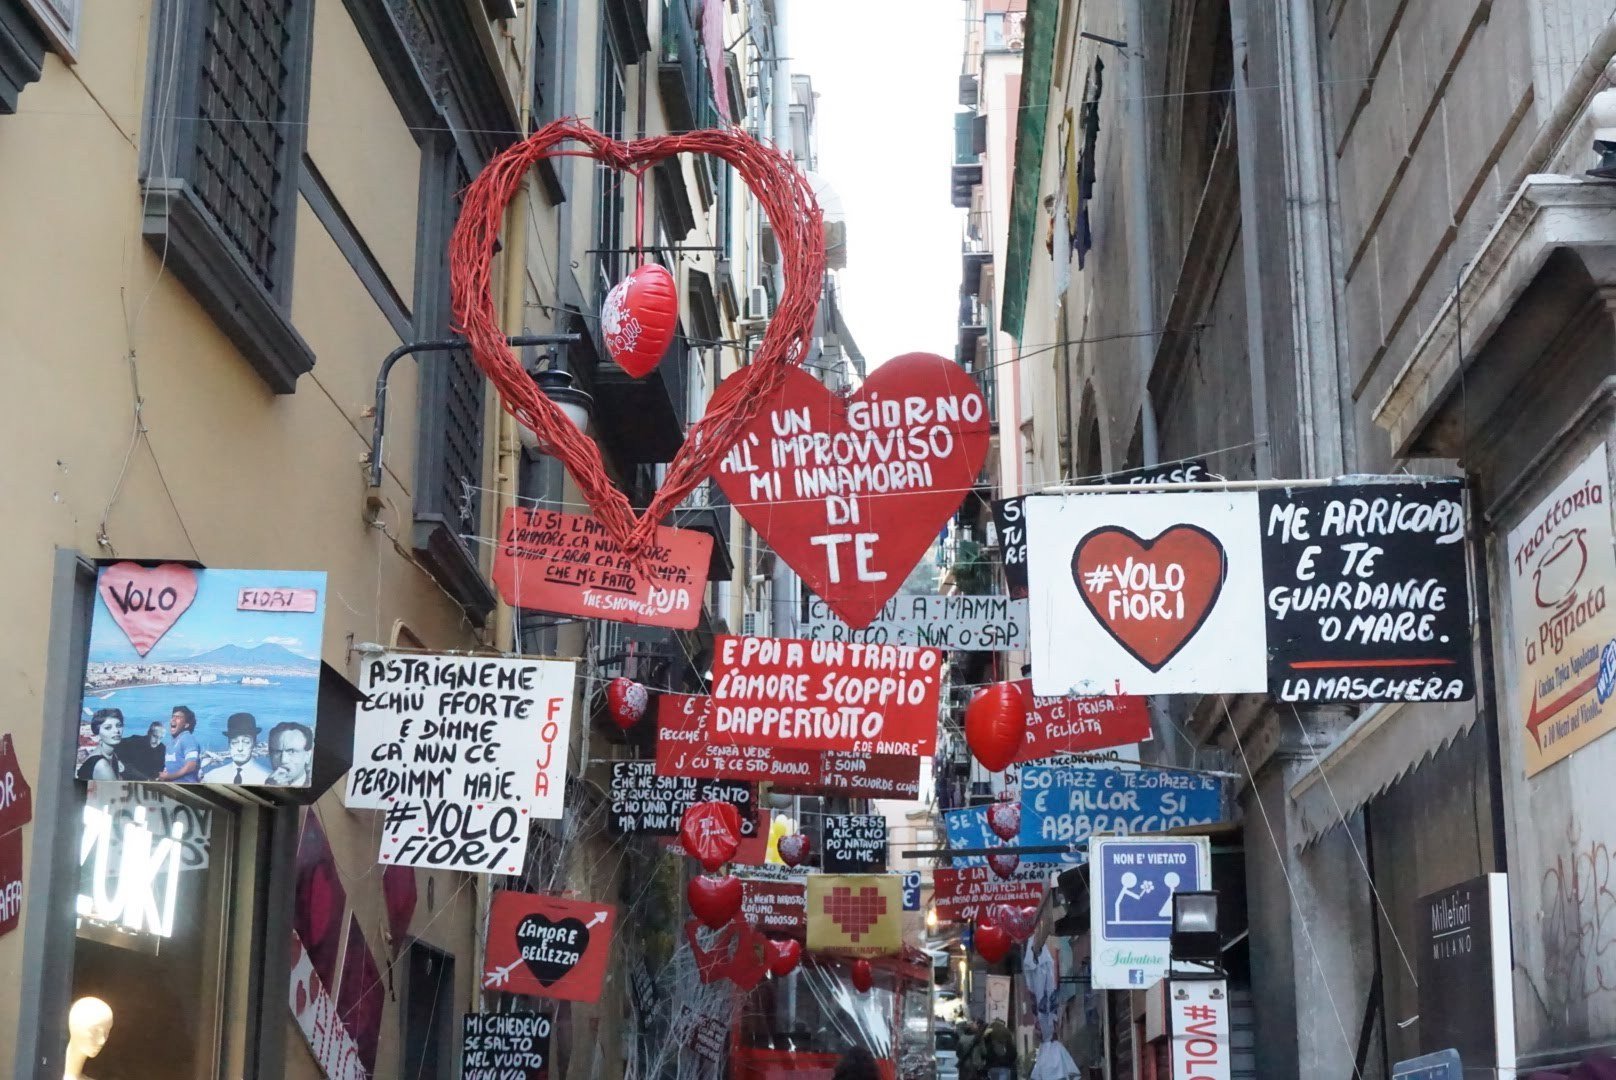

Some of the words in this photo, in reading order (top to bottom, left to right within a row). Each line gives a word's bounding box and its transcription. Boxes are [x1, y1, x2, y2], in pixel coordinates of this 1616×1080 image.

[771, 407, 811, 436] UN
[750, 470, 782, 501] MI
[794, 461, 932, 498] INNAMORAI
[825, 493, 860, 525] DI
[1268, 503, 1311, 544] ME
[810, 532, 887, 583] TE
[1296, 545, 1321, 580] E
[1340, 542, 1384, 578] TE
[546, 565, 571, 579] CHE
[601, 571, 636, 591] FATTO
[1084, 556, 1185, 593] #VOLO
[109, 581, 178, 616] VOLO
[241, 591, 294, 607] FIORI
[912, 598, 927, 620] A
[1108, 588, 1185, 621] FIORI
[1268, 578, 1447, 620] GUARDANNE
[1539, 585, 1606, 656] Pignata
[917, 622, 953, 646] NUN
[723, 639, 738, 666] E
[741, 637, 781, 667] POI
[787, 644, 803, 667] A
[811, 639, 845, 668] UN
[847, 645, 936, 671] TRATTO
[369, 657, 537, 690] ASTRIGNEME
[716, 668, 809, 701] L'AMORE
[1281, 679, 1310, 702] LA
[1314, 676, 1464, 701] MASCHERA
[438, 691, 535, 720] FFORTE
[400, 718, 414, 738] E
[419, 717, 499, 742] DIMME
[716, 706, 884, 739] DAPPERTUTTO
[413, 744, 456, 764] NUN
[465, 742, 501, 764] CE
[692, 758, 709, 768] CU
[713, 758, 725, 770] TE
[728, 759, 744, 770] CE
[746, 760, 769, 771] STO
[612, 777, 635, 789] CHE
[638, 777, 652, 788] NE
[656, 776, 677, 789] SAI
[679, 777, 697, 788] TU
[1056, 772, 1096, 789] PAZZ
[613, 790, 626, 801] DE
[628, 789, 672, 801] QUELLO
[674, 789, 697, 801] CHE
[702, 786, 749, 803] SENTO
[1035, 790, 1049, 813] E
[1069, 790, 1141, 813] ALLOR
[1159, 792, 1186, 815] SI
[643, 802, 667, 814] UNA
[619, 816, 636, 832] MA
[643, 814, 670, 830] NUN
[826, 817, 834, 829] A
[836, 816, 849, 828] TE
[851, 817, 885, 829] STESS
[864, 829, 883, 839] NO
[394, 836, 521, 870] FIORI
[836, 850, 852, 860] CU
[1113, 853, 1135, 865] NON
[1137, 853, 1146, 864] E'
[1147, 853, 1187, 865] VIETATO
[518, 919, 578, 945] L'AMORE
[522, 945, 579, 965] BELLEZZA
[1102, 947, 1163, 967] Salvatore
[1433, 934, 1471, 960] MILANO
[467, 1013, 483, 1035] MI
[485, 1013, 550, 1037] CHIEDEVO
[465, 1036, 480, 1050] SE
[484, 1036, 532, 1051] SALTO
[466, 1051, 490, 1067] NEL
[494, 1053, 542, 1068] VUOTO
